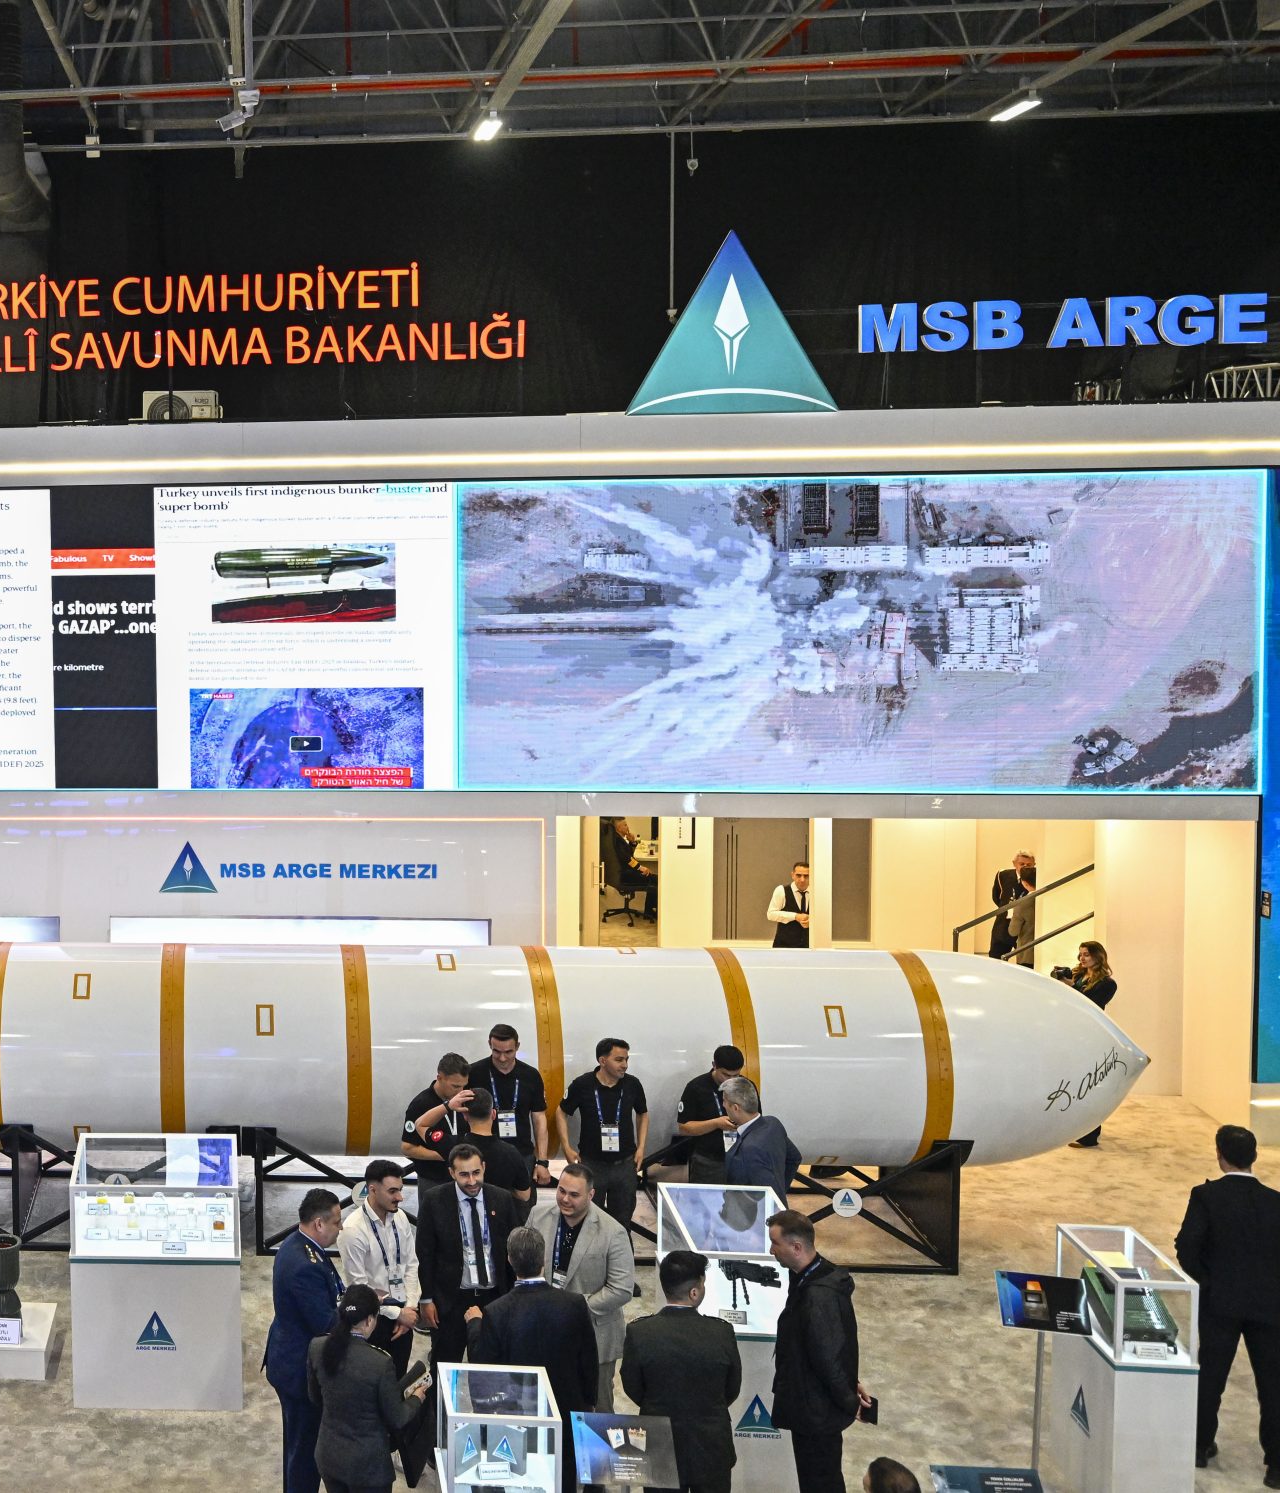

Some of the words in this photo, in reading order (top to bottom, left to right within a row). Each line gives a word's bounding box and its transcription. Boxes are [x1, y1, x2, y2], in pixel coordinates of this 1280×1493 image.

[113, 261, 420, 318] CUMHURİYETİ
[858, 299, 1024, 353] MSB
[1046, 293, 1268, 348] ARGE
[51, 325, 271, 372] SAVUNMA
[283, 313, 525, 365] BAKANLIĞI
[157, 488, 199, 499] Turkey
[202, 487, 243, 497] unveils
[245, 486, 268, 496] first
[271, 486, 335, 497] indigenous
[425, 484, 447, 493] and
[2, 585, 37, 593] powerful
[68, 601, 117, 615] shows
[220, 864, 265, 878] MSB
[273, 863, 332, 878] ARGE
